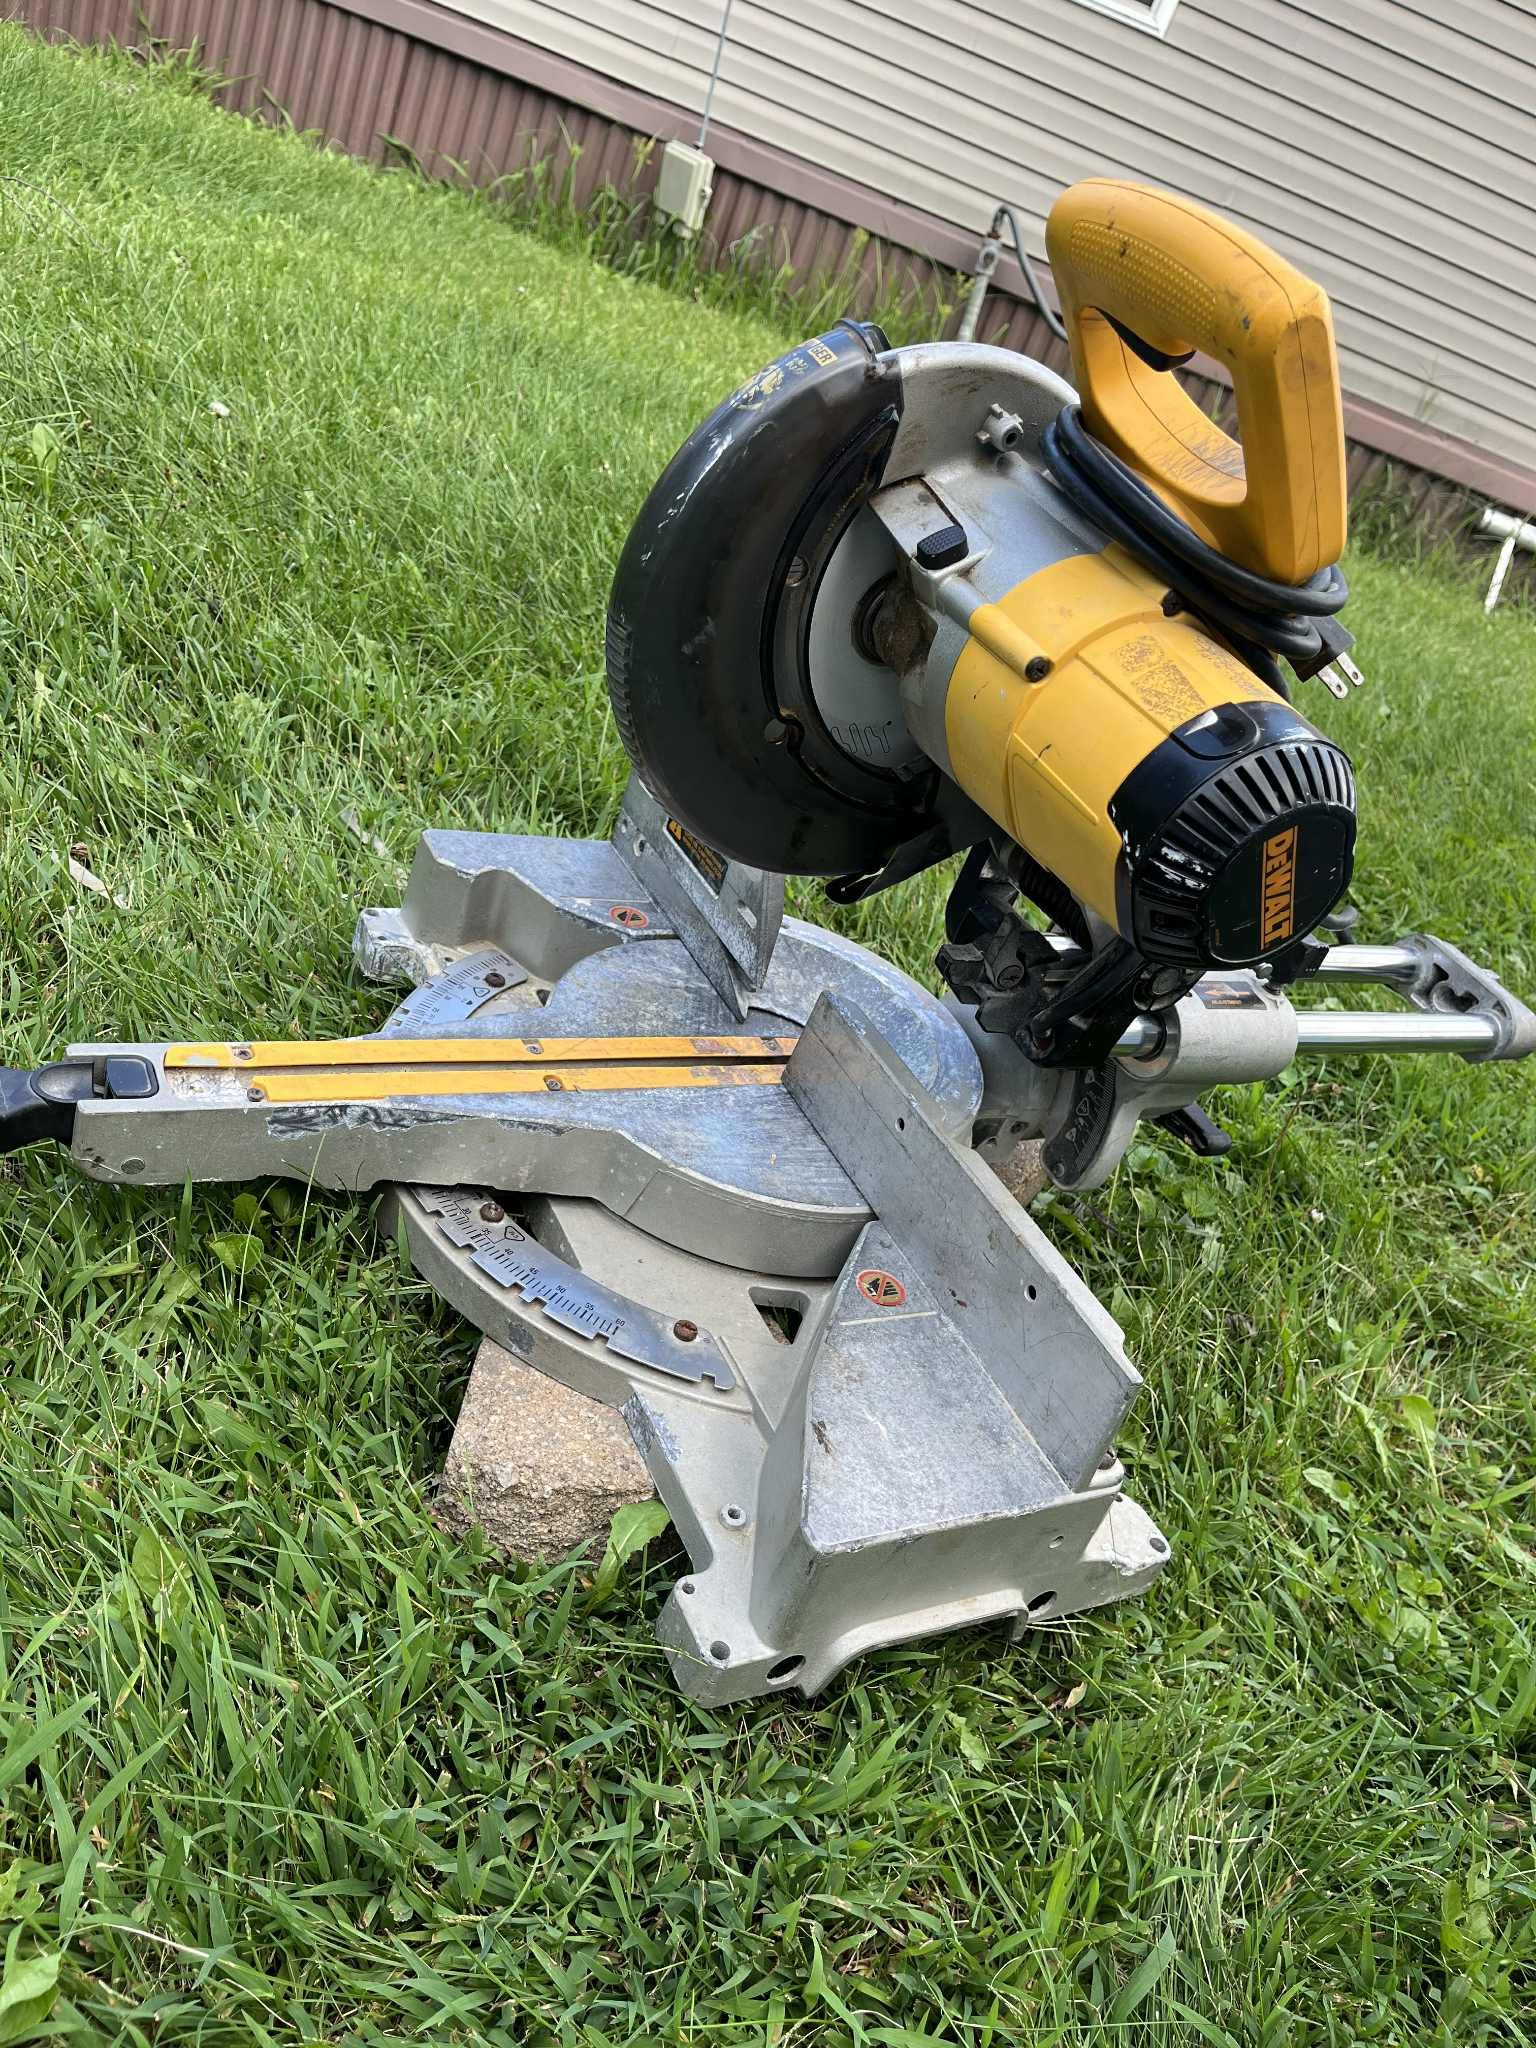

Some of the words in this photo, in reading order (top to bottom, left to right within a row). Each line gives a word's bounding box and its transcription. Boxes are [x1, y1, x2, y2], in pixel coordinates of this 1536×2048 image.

[1264, 826, 1294, 945] DEWALT
[504, 1247, 514, 1256] 40
[528, 1266, 539, 1275] 45
[555, 1284, 567, 1294] 50
[584, 1302, 595, 1311] 55
[615, 1318, 626, 1327] 60
